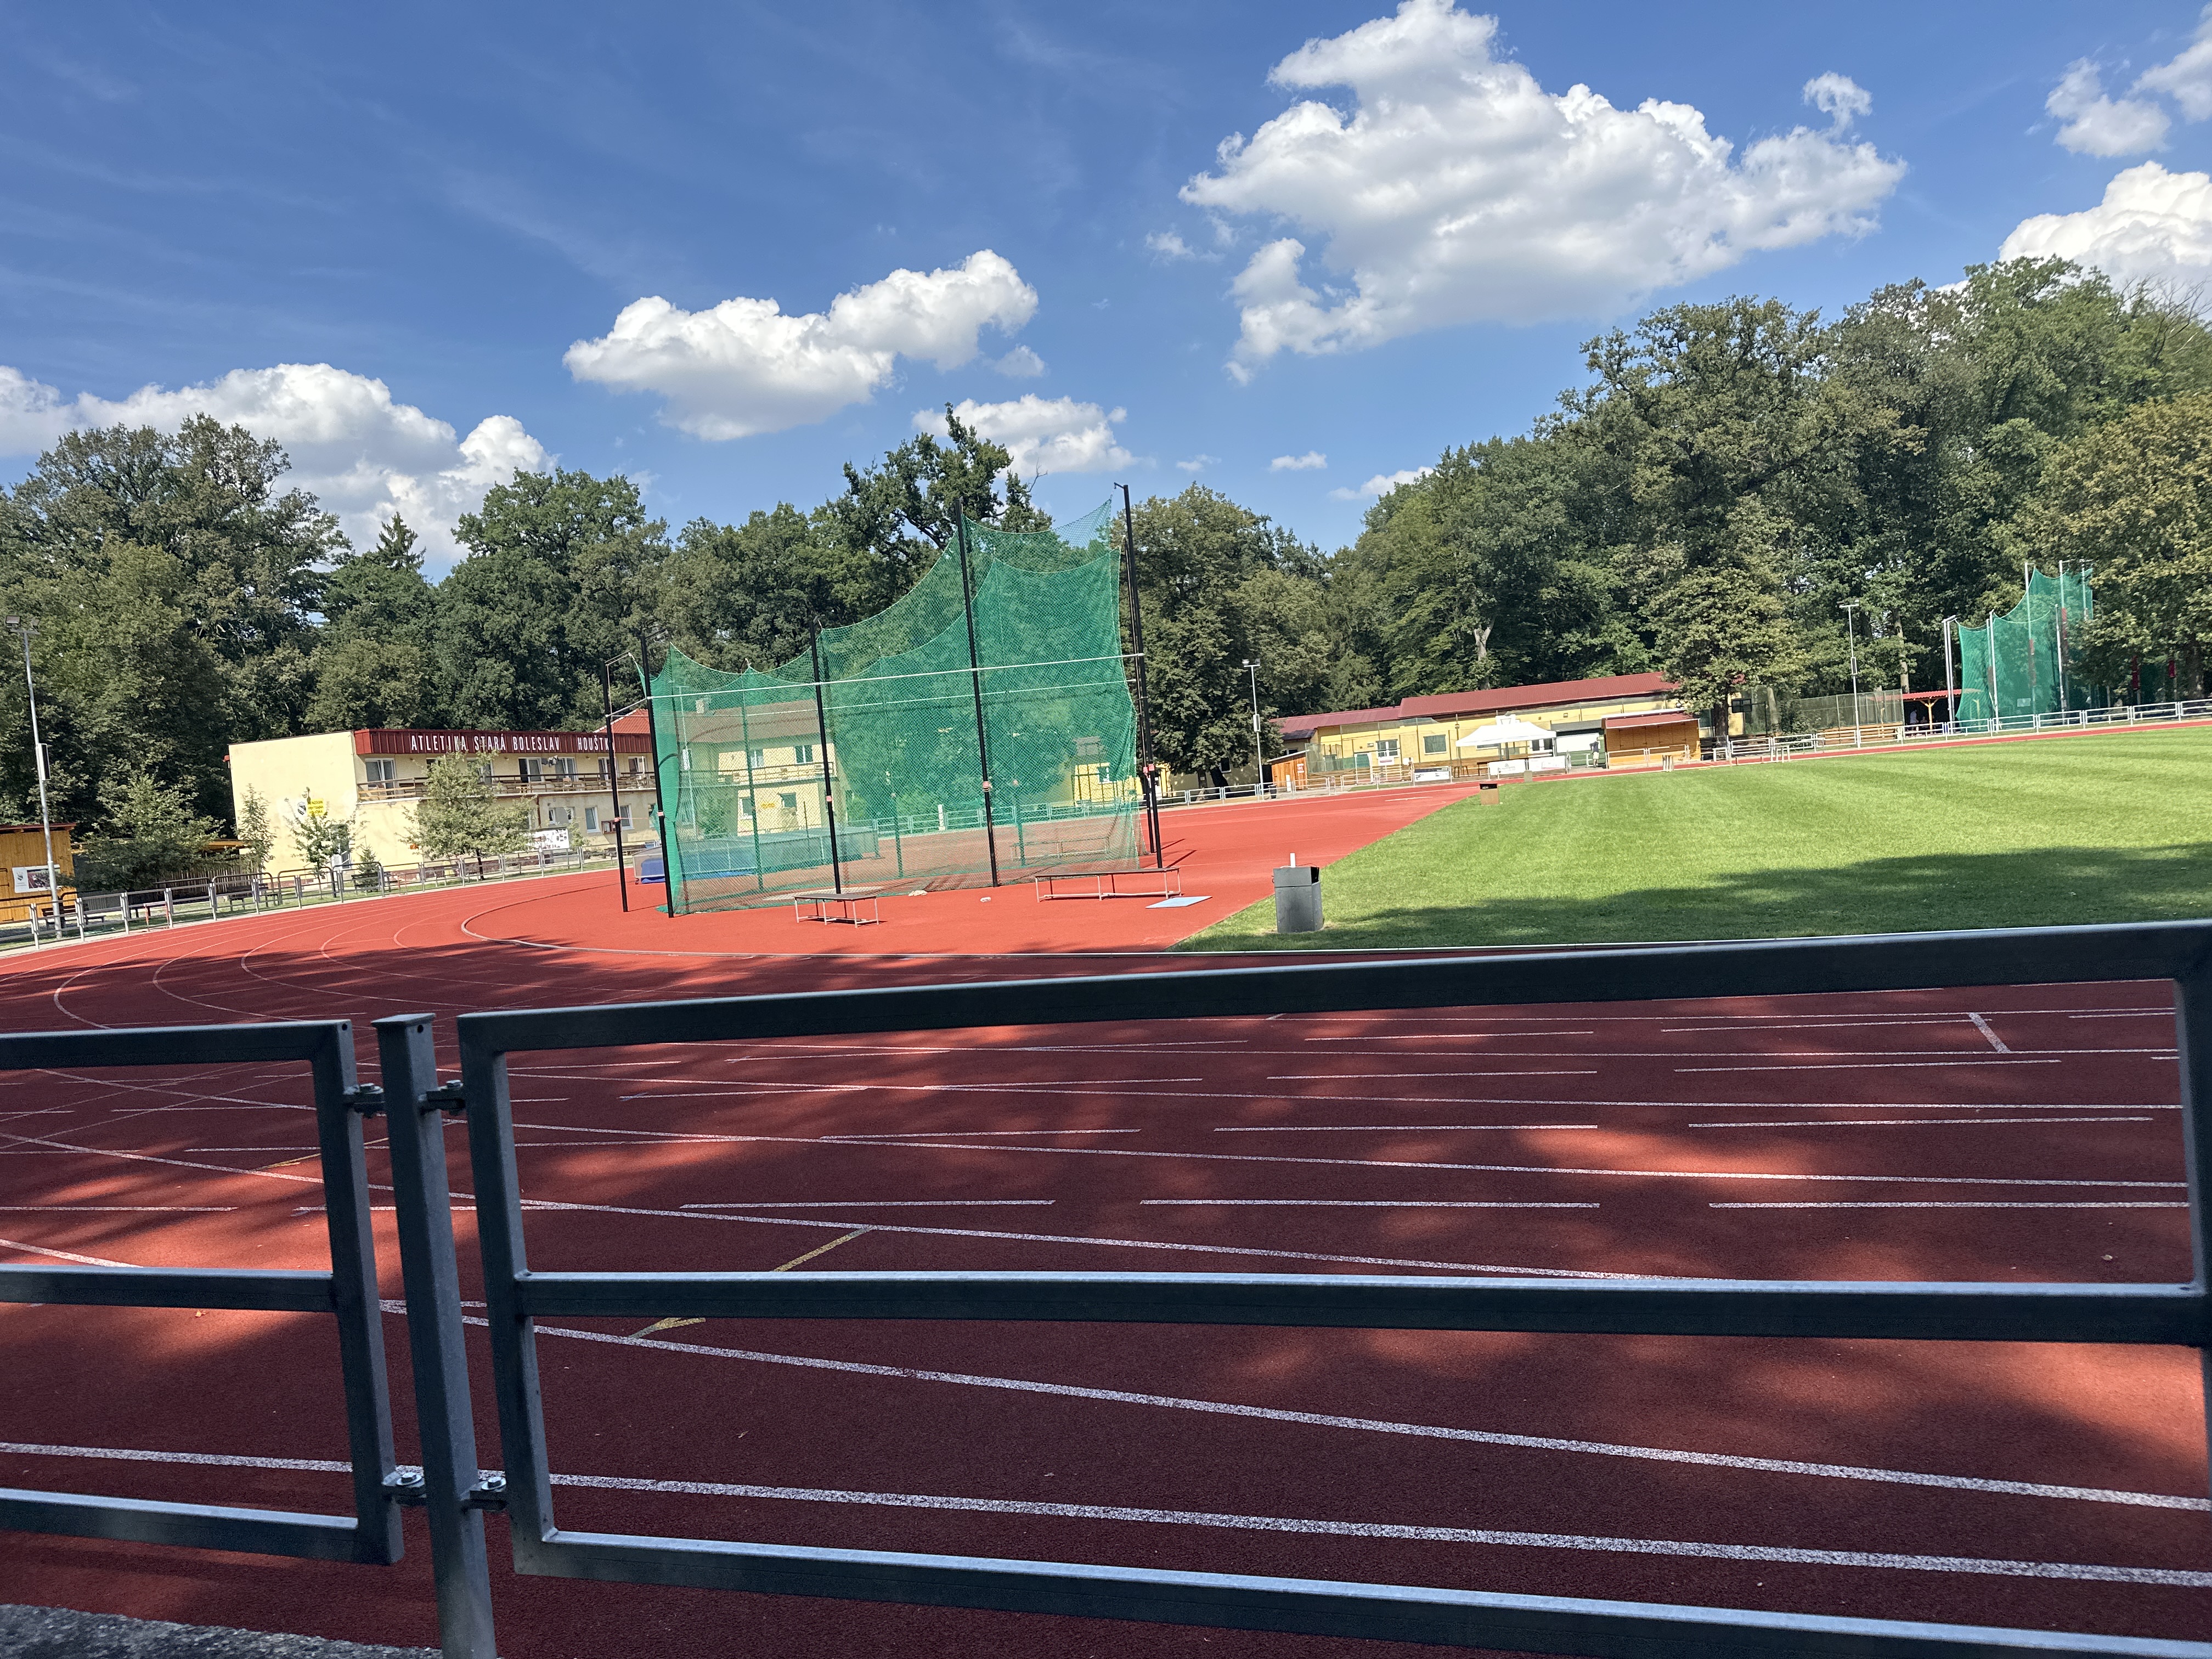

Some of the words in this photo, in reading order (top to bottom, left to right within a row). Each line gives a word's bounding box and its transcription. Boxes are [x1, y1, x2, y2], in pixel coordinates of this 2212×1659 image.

[411, 735, 467, 751] ATLETIKA
[474, 733, 506, 751] STARÁ
[512, 736, 560, 751] BOLESLAV
[578, 735, 614, 751] HOUŠTK
